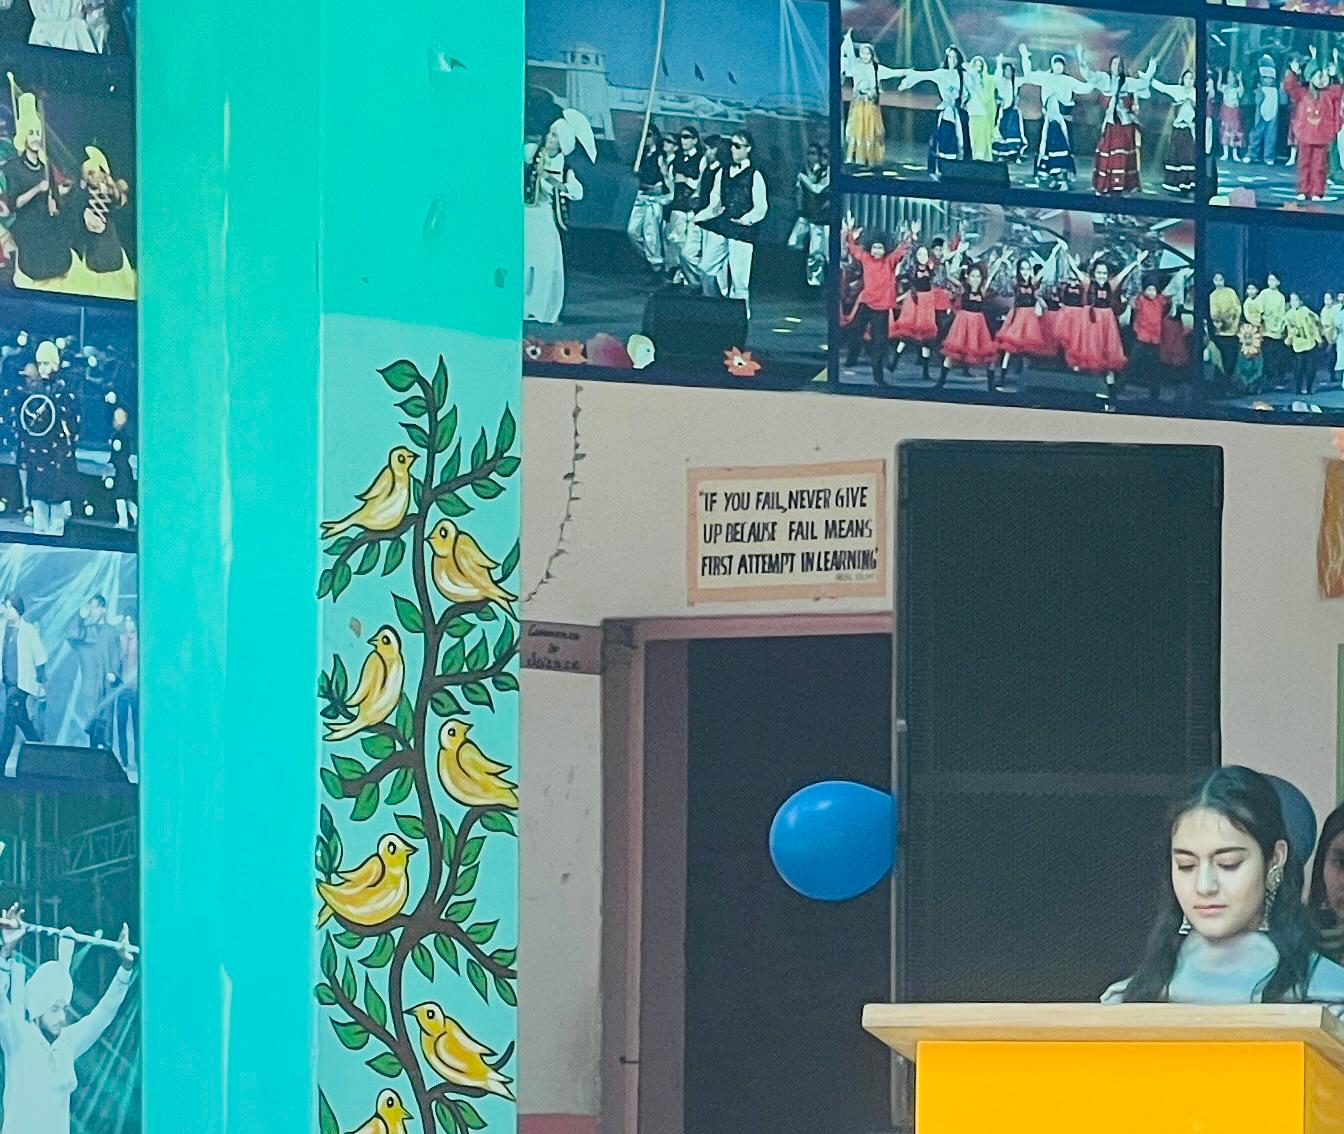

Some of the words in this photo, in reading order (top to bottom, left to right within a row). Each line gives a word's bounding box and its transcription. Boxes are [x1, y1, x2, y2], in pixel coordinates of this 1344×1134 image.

[724, 491, 750, 512] YOU
[835, 486, 868, 508] GIVE
[703, 523, 722, 544] UP
[725, 521, 777, 543] BECAUSE
[788, 520, 818, 541] FAIL
[824, 518, 872, 539] MEANS
[701, 555, 733, 576] FIRST
[737, 552, 795, 575] ATTEMPT
[801, 551, 815, 572] IN
